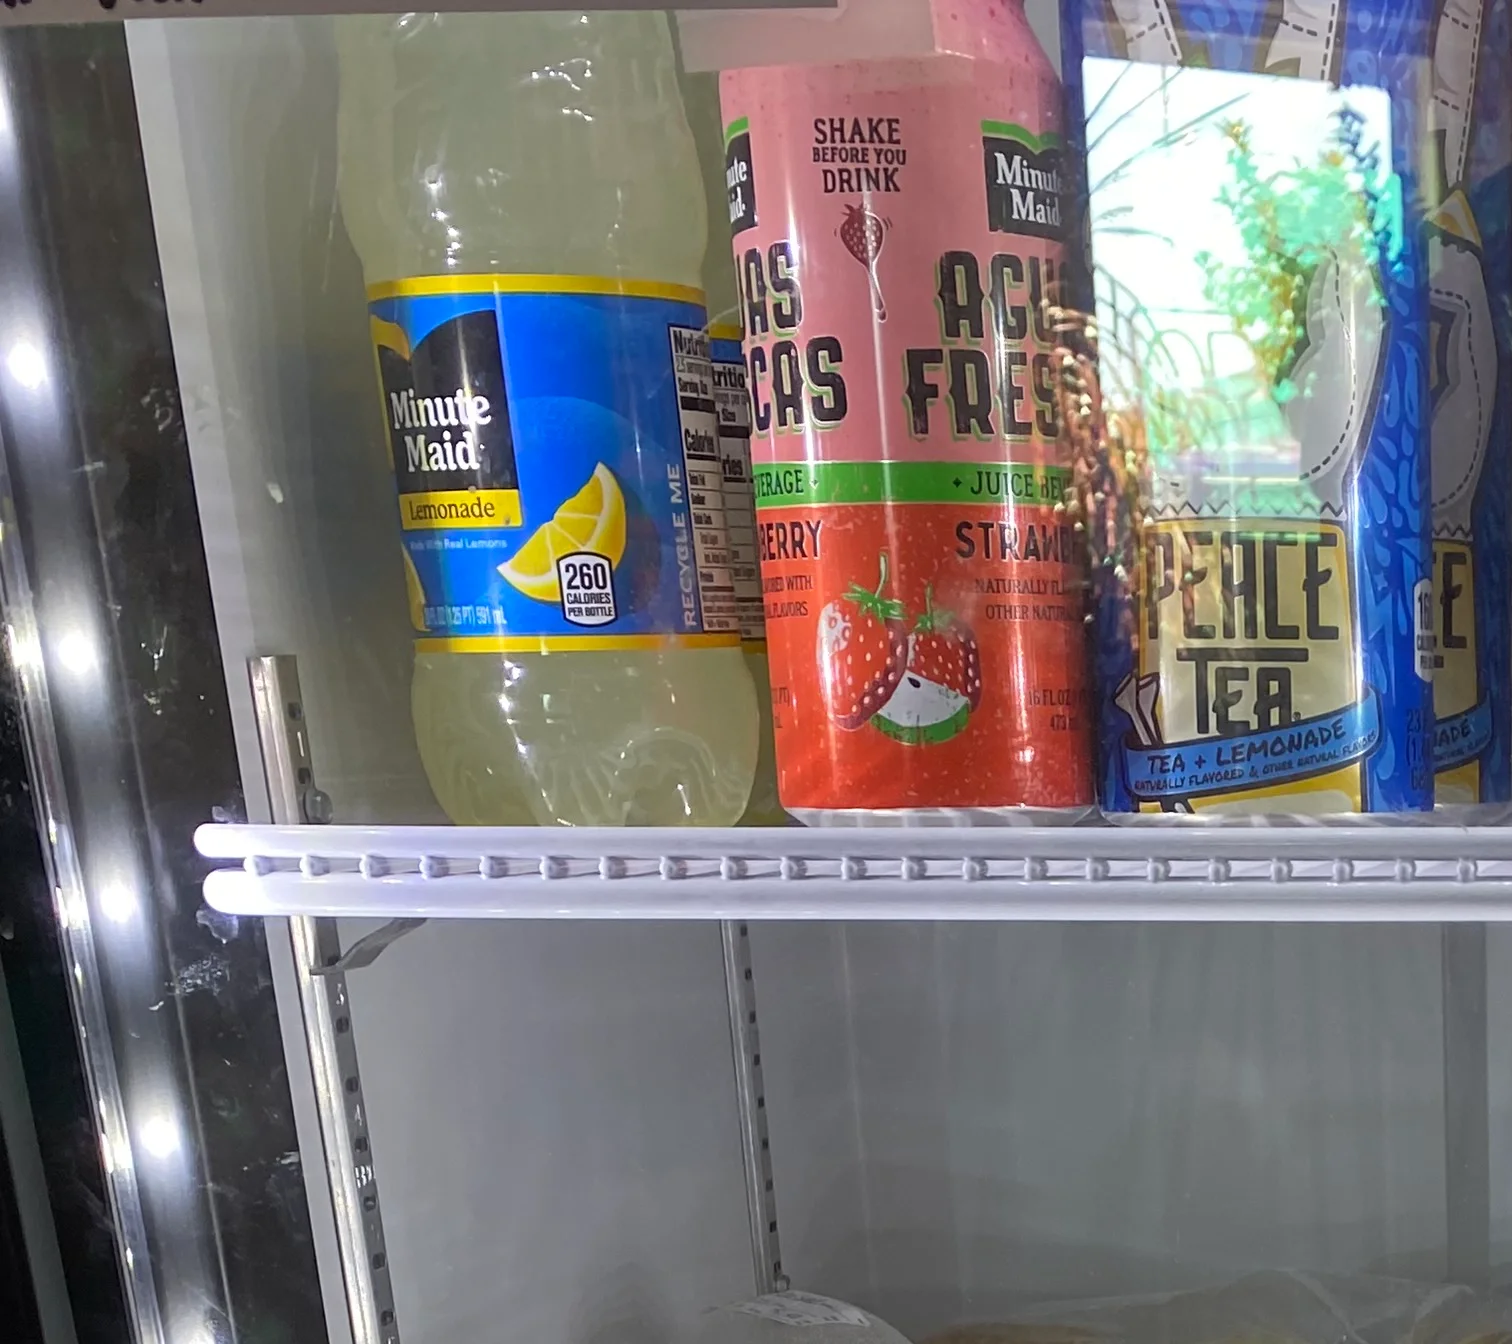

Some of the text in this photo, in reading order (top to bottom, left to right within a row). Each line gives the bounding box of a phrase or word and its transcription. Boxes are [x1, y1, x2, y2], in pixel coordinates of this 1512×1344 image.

[813, 117, 901, 145] SHAKE
[812, 146, 907, 166] BEFORE YOU
[822, 167, 901, 194] DRINK
[1011, 189, 1061, 227] Maid
[736, 242, 802, 337] AS
[744, 336, 848, 434] CAS
[390, 388, 492, 430] Minute
[405, 428, 481, 473] Maid
[667, 463, 683, 504] ME
[970, 471, 1033, 497] JUICE
[408, 497, 495, 521] Lemonade
[444, 538, 463, 549] Real
[466, 537, 507, 549] Lemons
[565, 563, 608, 590] 260
[785, 575, 813, 591] WITH
[976, 578, 1048, 595] NATURALLY
[1145, 531, 1340, 640] PEACE
[566, 592, 611, 605] CALORIES
[568, 605, 614, 617] PER BOTTLE
[985, 605, 1028, 620] OTHER
[1176, 648, 1309, 736] TEA
[1148, 718, 1346, 775] TEA + LEMONADE
[1134, 776, 1187, 790] NATURALLY
[1188, 769, 1245, 787] FLAVORED
[1262, 760, 1294, 775] OTHER
[1298, 750, 1339, 767] NATURAL
[1343, 731, 1377, 754] FLAVORS
